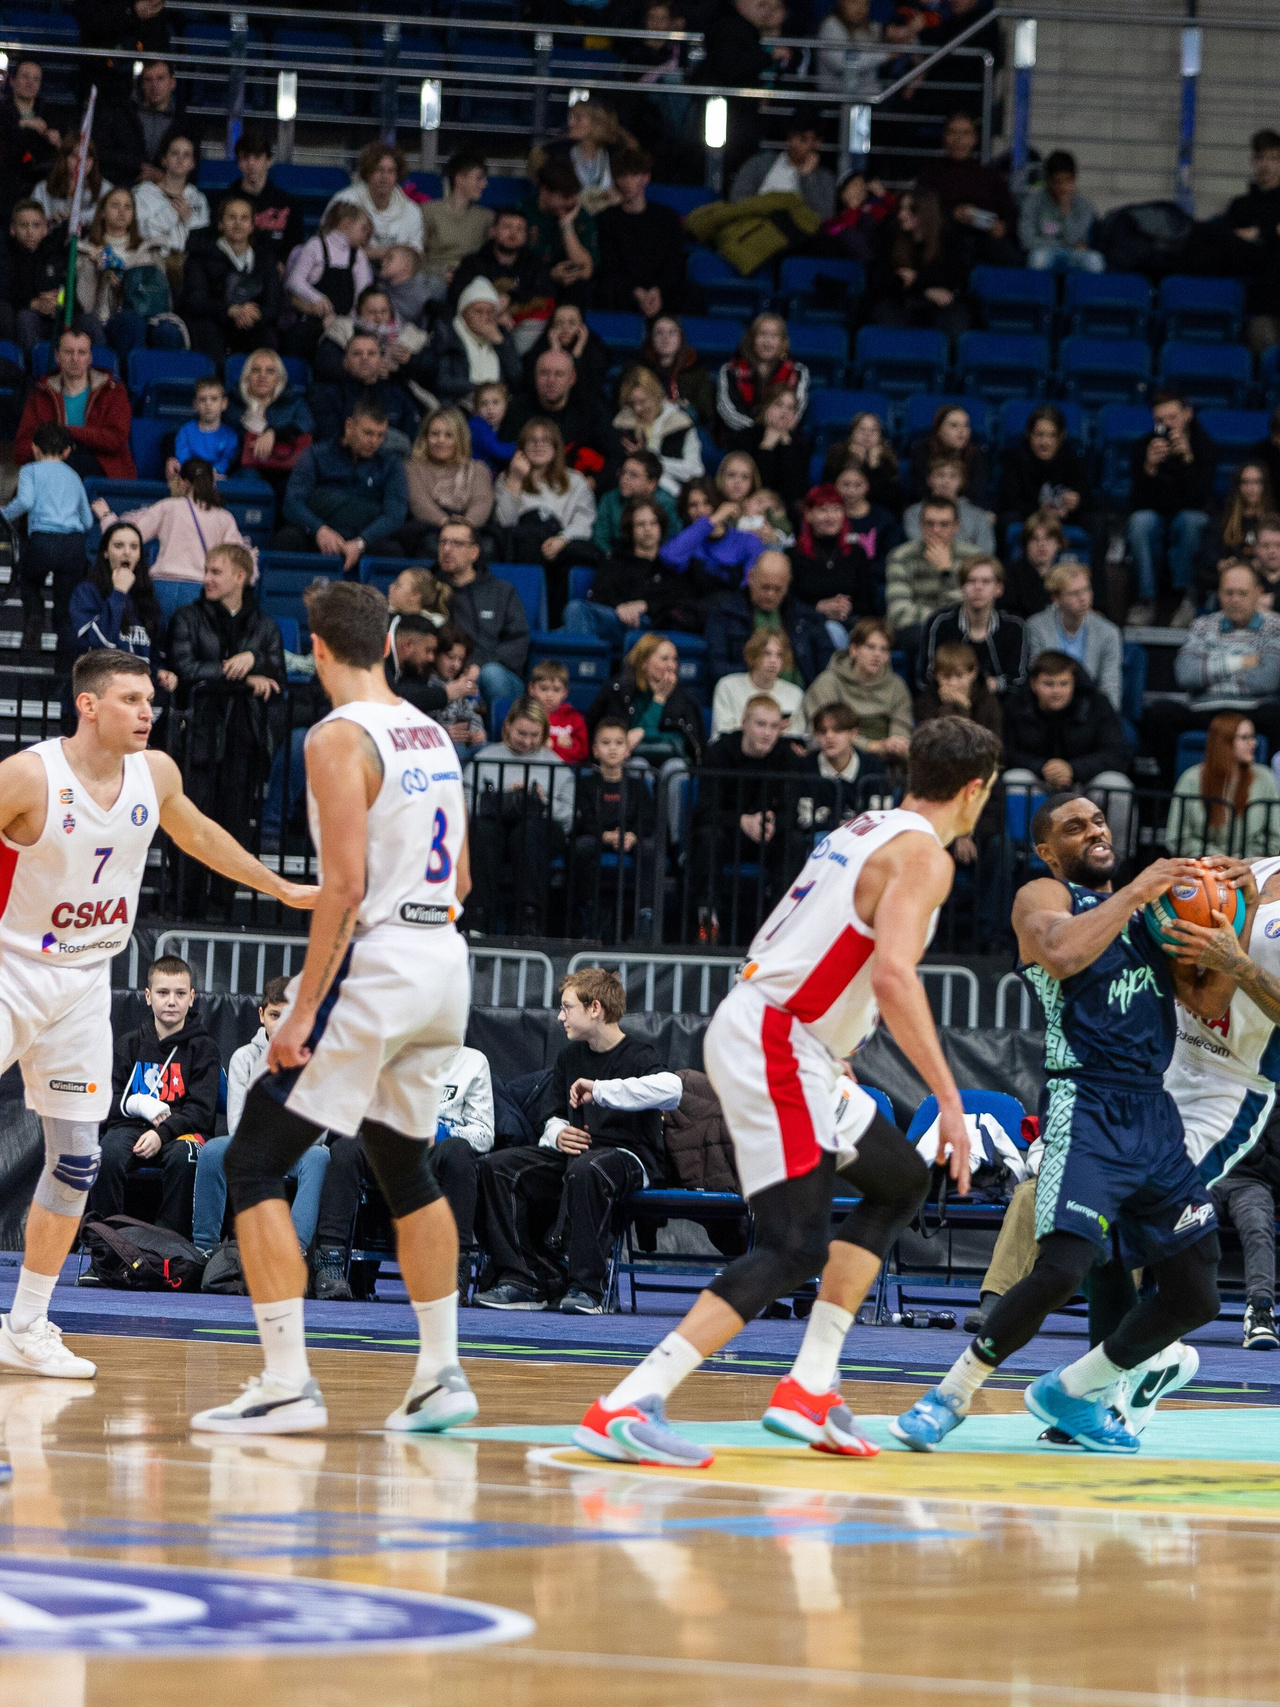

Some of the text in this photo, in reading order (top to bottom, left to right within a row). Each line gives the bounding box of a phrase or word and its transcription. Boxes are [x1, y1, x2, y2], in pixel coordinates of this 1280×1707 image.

[92, 847, 114, 884] 7
[51, 897, 128, 929] CSKA
[404, 905, 448, 922] Winline
[59, 941, 121, 953] Rostecom
[1175, 1026, 1231, 1058] ostelecom
[51, 1081, 86, 1093] Winline
[1066, 1200, 1099, 1220] Kempa
